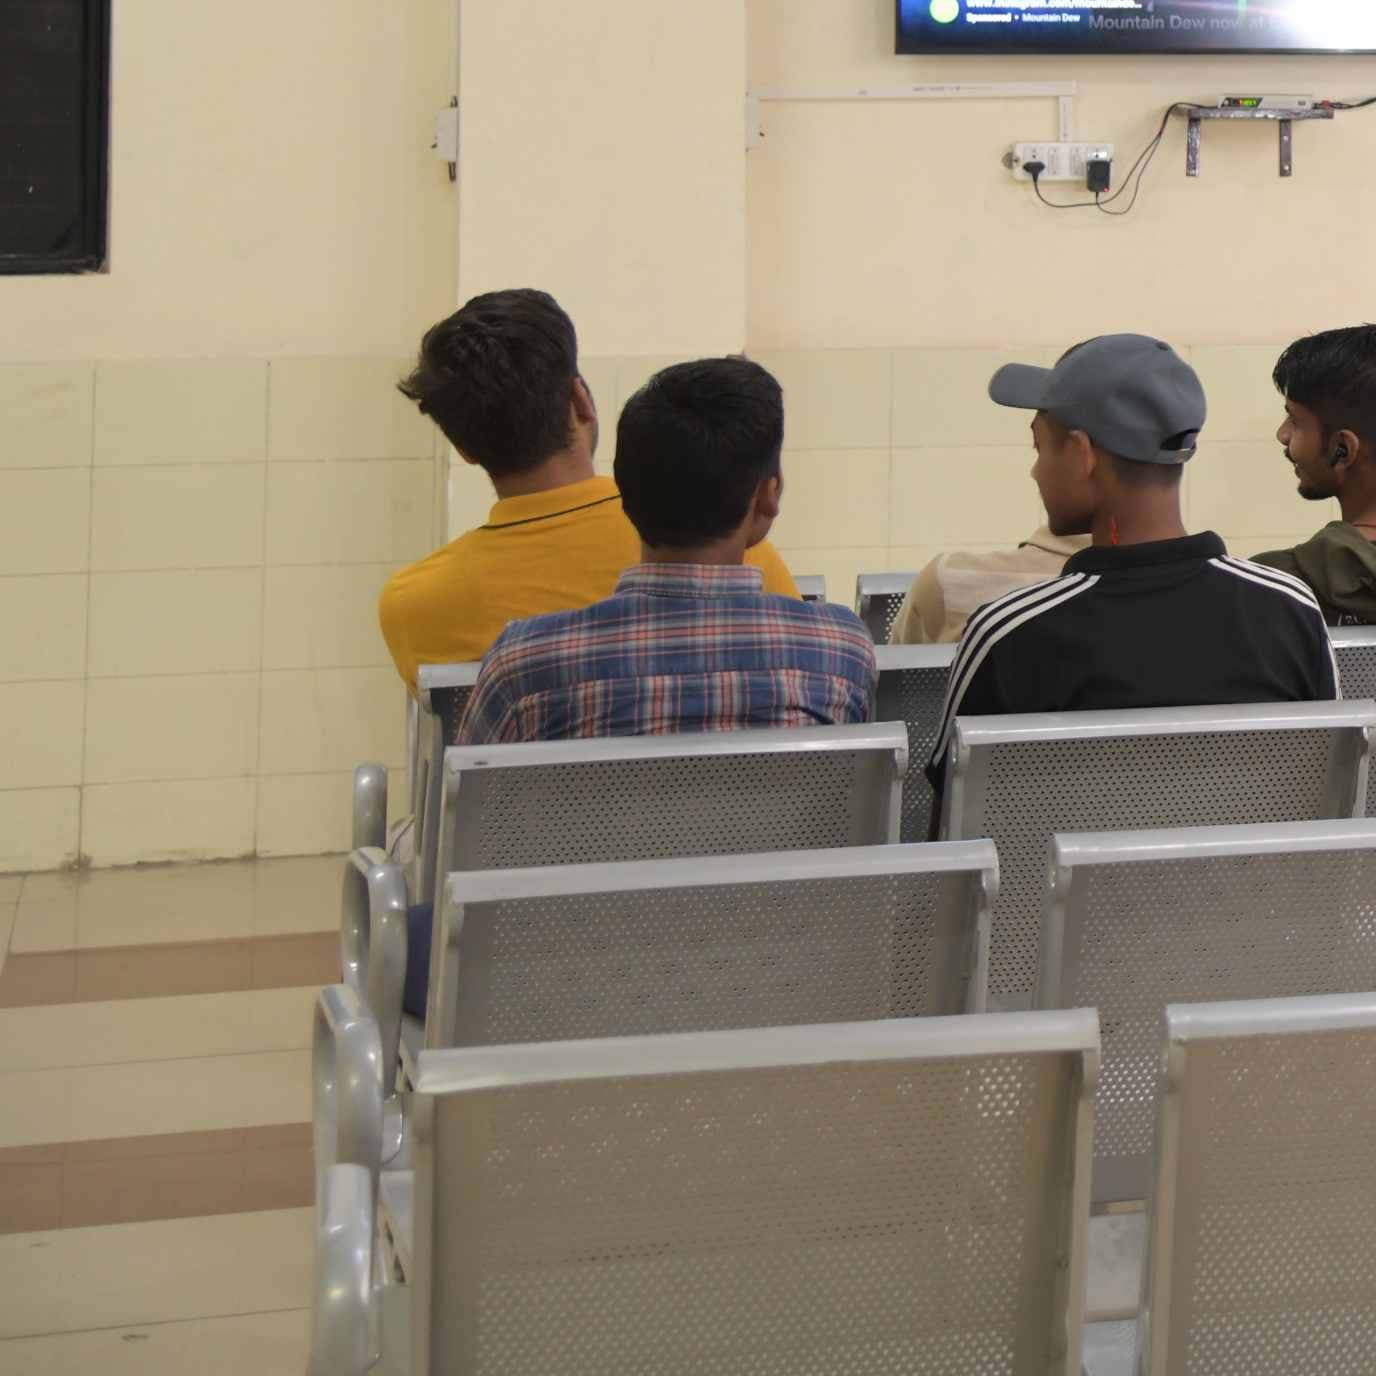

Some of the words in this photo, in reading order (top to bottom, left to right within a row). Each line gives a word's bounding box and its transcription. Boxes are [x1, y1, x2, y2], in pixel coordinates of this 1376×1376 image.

[1022, 12, 1061, 23] Mountain
[1062, 13, 1081, 23] Dew
[1088, 14, 1165, 30] Mountain
[1169, 14, 1205, 30] Dew
[1210, 17, 1241, 30] now
